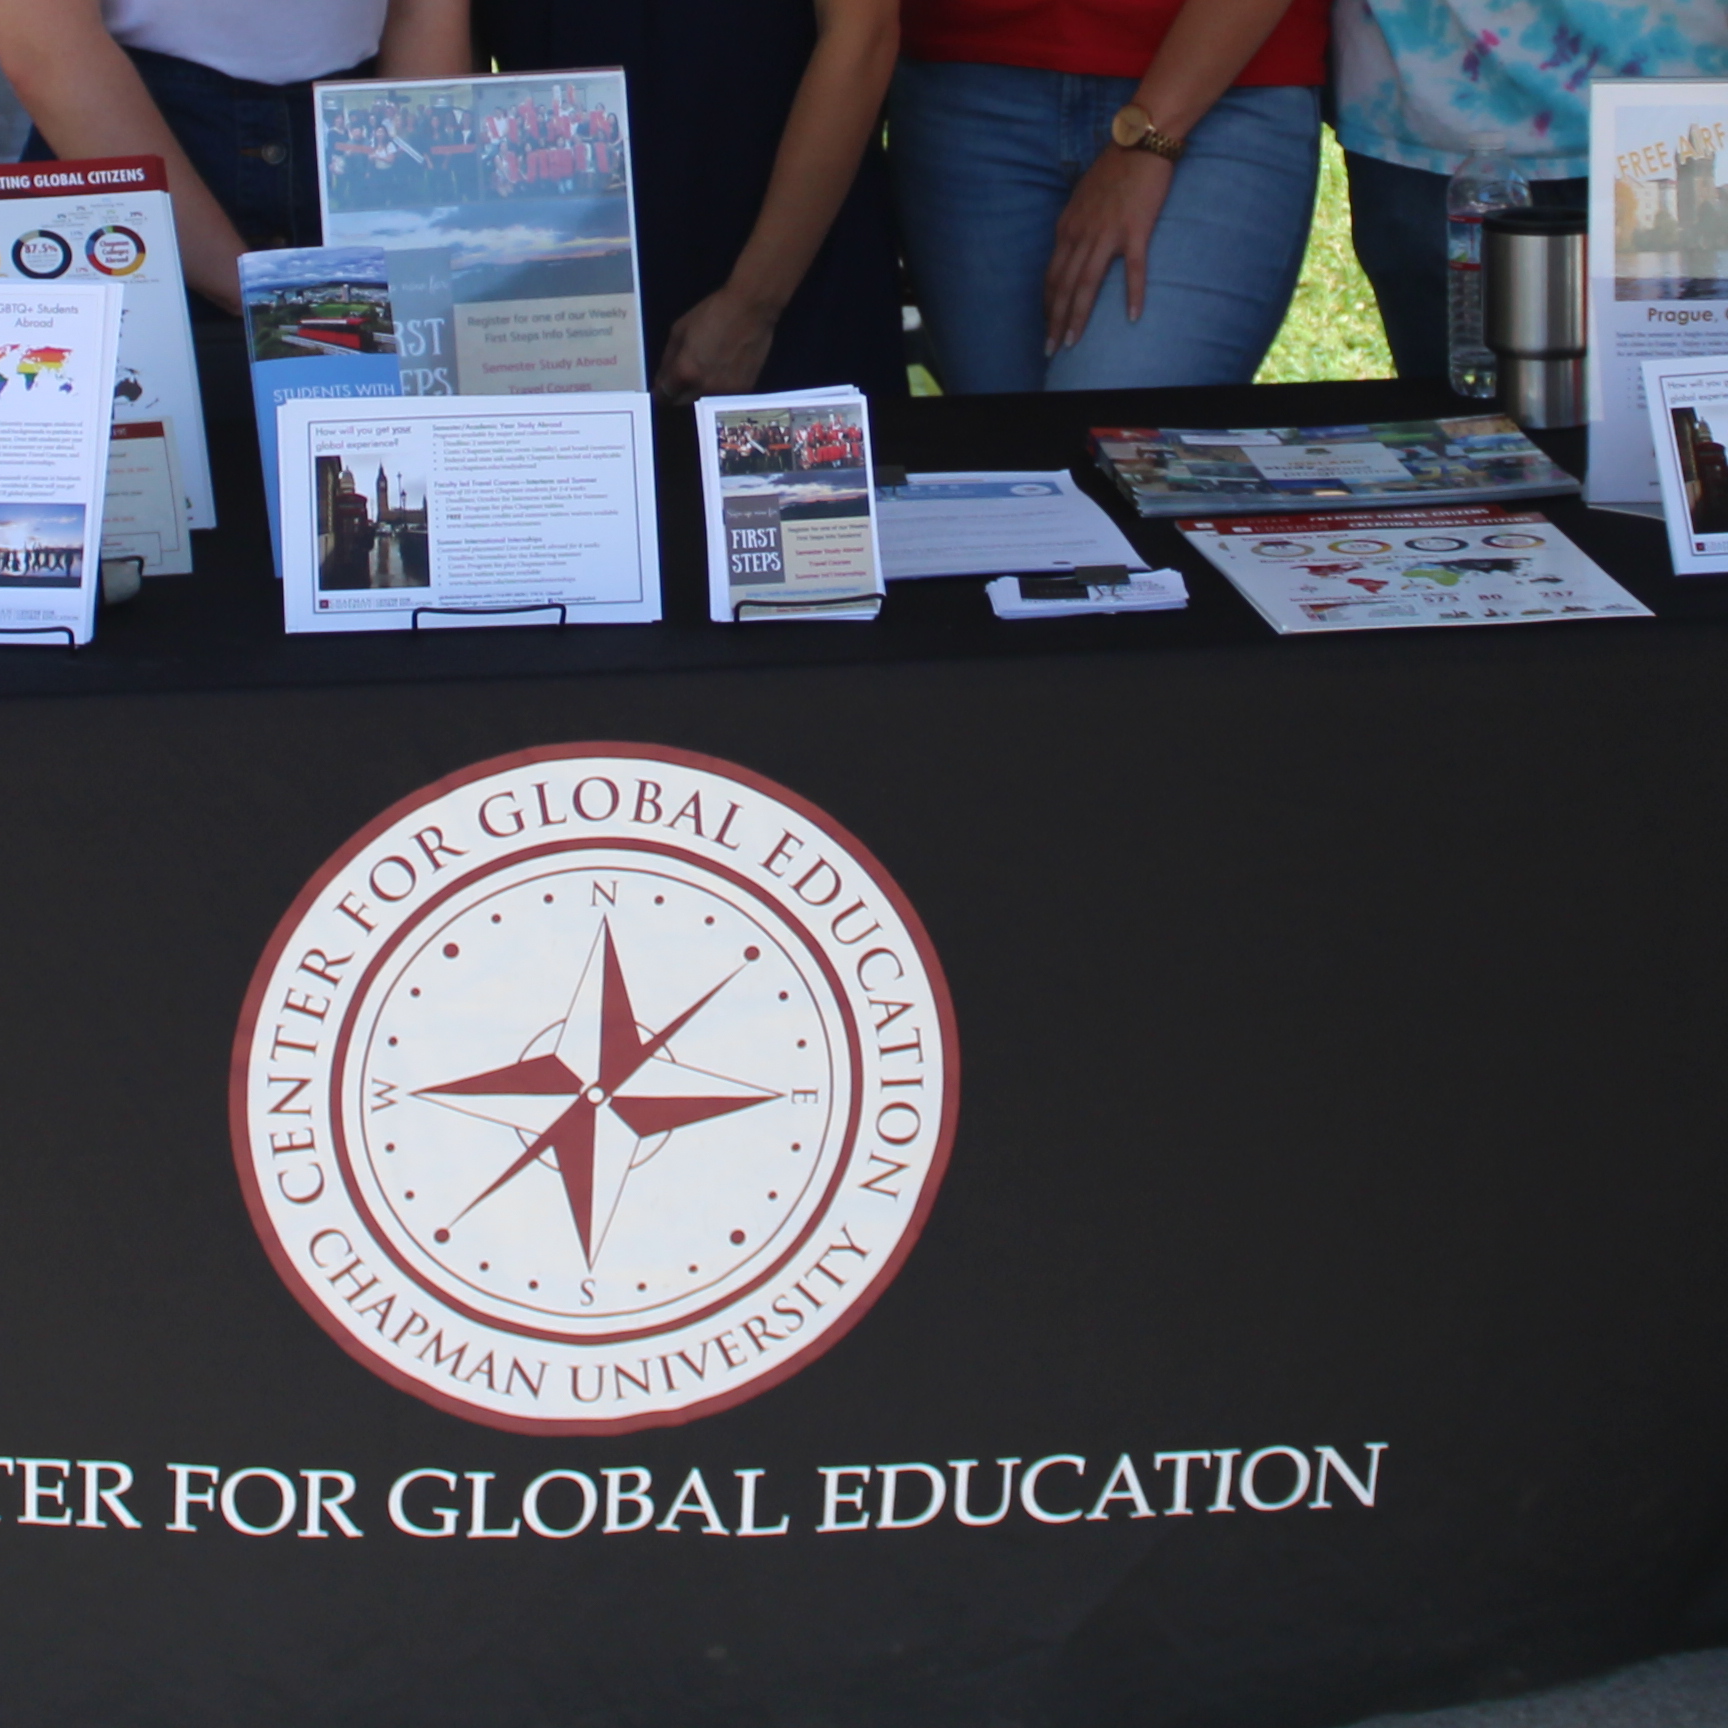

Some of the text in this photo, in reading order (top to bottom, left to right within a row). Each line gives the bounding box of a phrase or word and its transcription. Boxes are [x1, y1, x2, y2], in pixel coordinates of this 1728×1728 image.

[1616, 142, 1672, 177] FREE
[34, 172, 84, 187] GLOBAL
[88, 168, 145, 184] CITIZENS
[24, 243, 58, 254] 87.5%
[37, 304, 79, 314] Students
[467, 307, 627, 328] Register for one of our Weekly
[1648, 307, 1717, 326] Prague,
[14, 318, 54, 328] Abroad
[393, 317, 445, 358] RST
[484, 331, 507, 344] First
[510, 330, 539, 344] Steps
[542, 328, 563, 341] Info
[482, 355, 618, 374] Semester Study Abroad
[273, 383, 395, 402] STUDENTS WITH
[547, 381, 592, 392] Courses
[1668, 380, 1689, 389] How
[1691, 379, 1704, 388] will
[1705, 380, 1722, 389] you
[1670, 393, 1696, 404] global
[315, 425, 411, 436] How will you get your
[315, 438, 399, 452] global experience?
[730, 527, 777, 549] FIRST
[731, 552, 781, 573] STEPS
[589, 880, 620, 908] N
[267, 776, 925, 1205] CENTER FOR GLOBAL EDUCATION
[371, 1078, 399, 1113] W
[790, 1088, 819, 1105] E
[579, 1279, 597, 1307] S
[307, 1224, 872, 1404] CHAPMAN UNIVERSITY
[164, 1461, 364, 1538] FOR
[385, 1468, 791, 1538] GLOBAL
[812, 1441, 1389, 1533] EDUCATION
